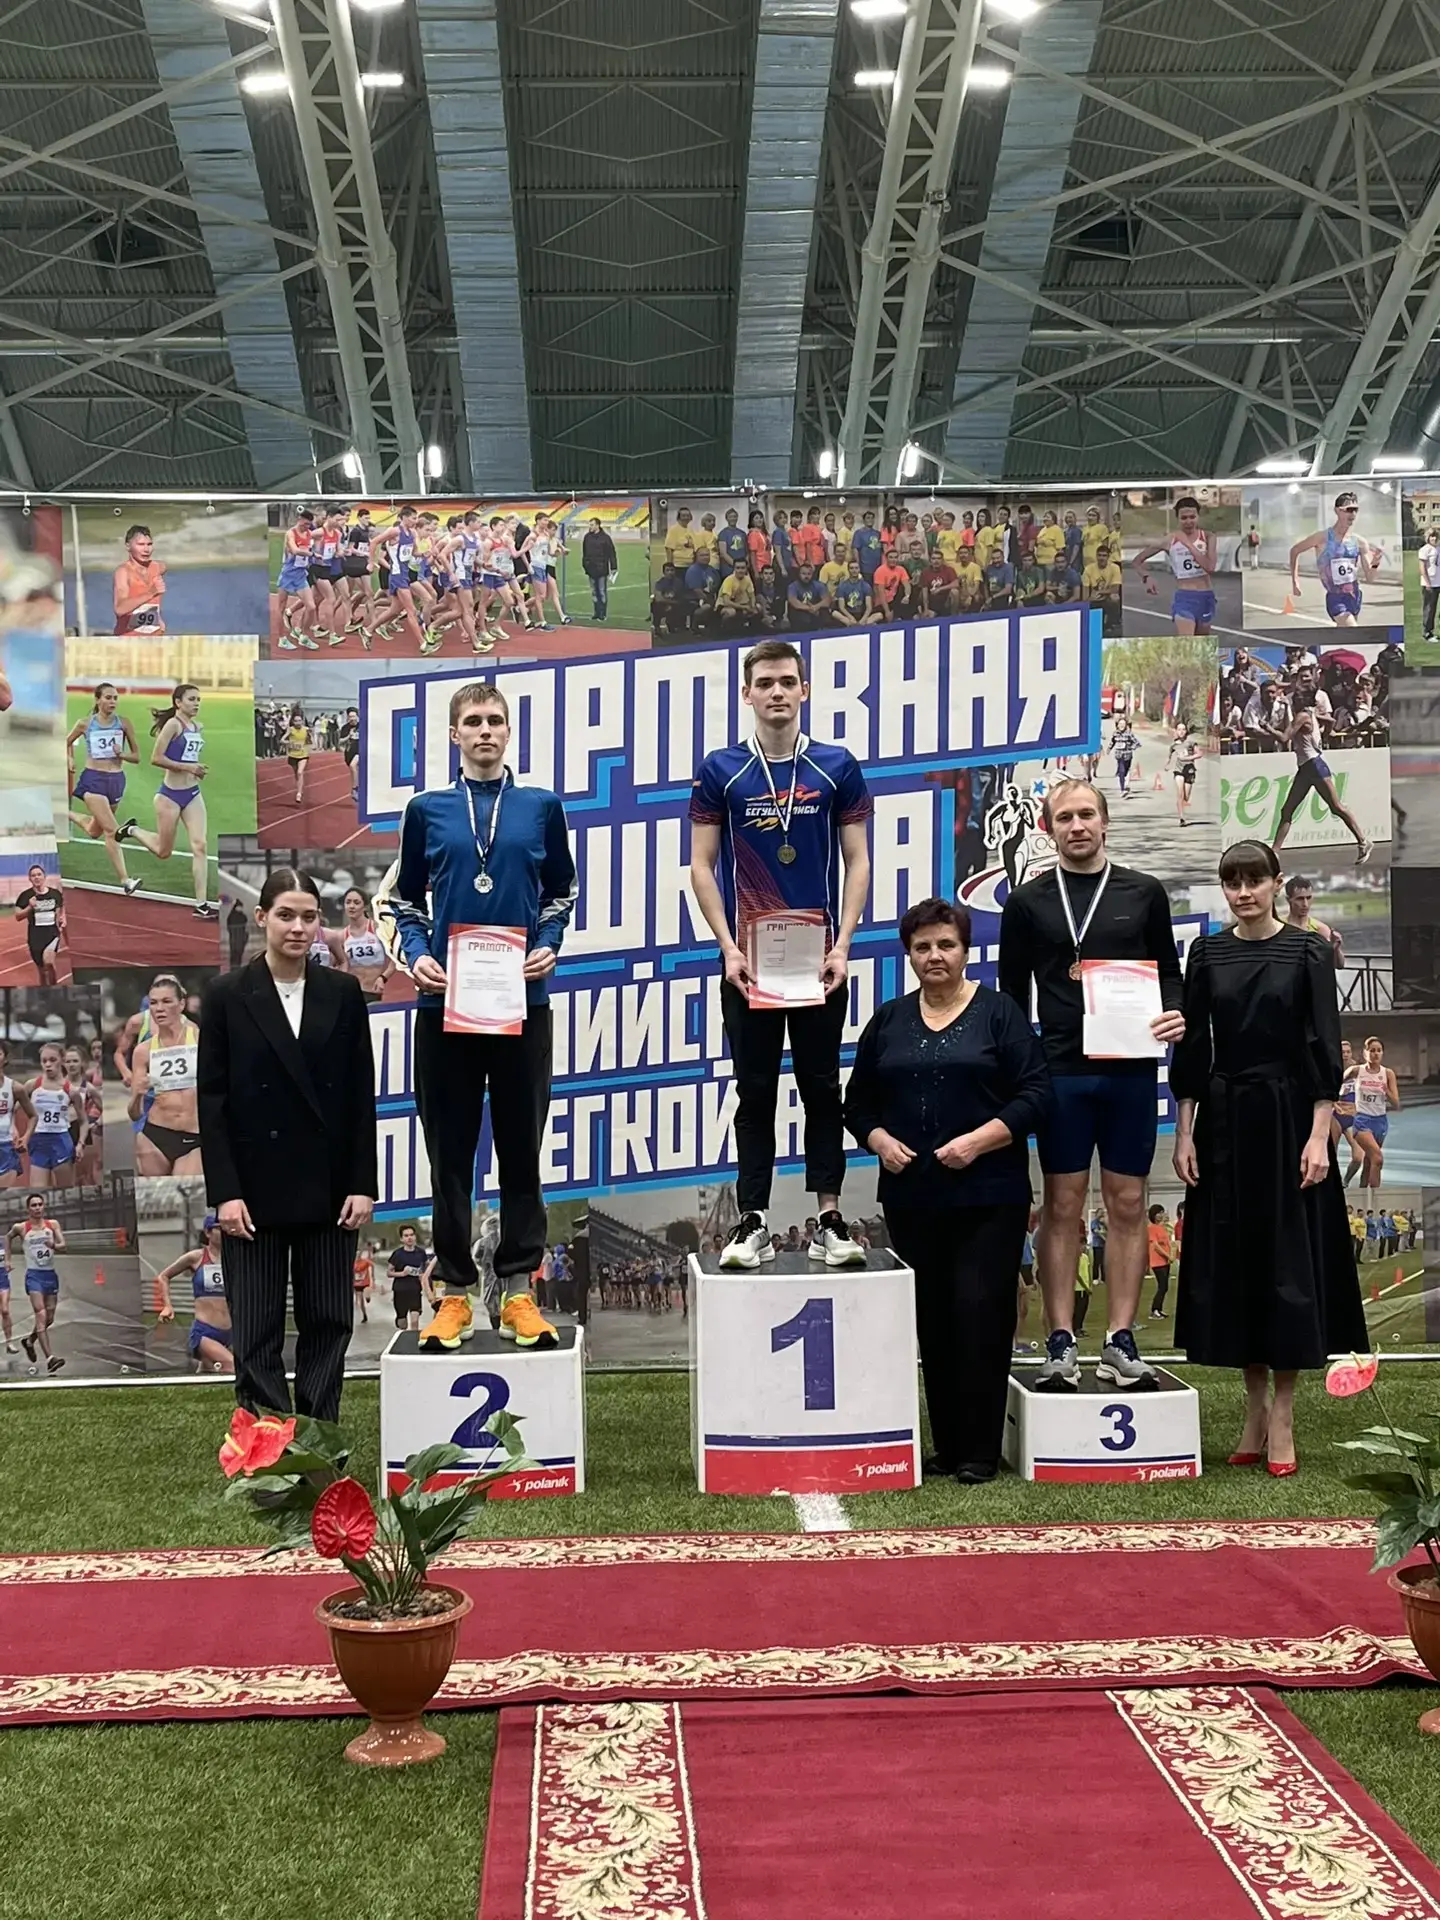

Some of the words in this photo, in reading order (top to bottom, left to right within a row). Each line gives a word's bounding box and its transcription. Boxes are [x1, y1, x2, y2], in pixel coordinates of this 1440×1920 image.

[137, 613, 154, 625] 99
[367, 611, 1082, 815] СПОРТВНАЯ
[98, 737, 116, 749] 34
[557, 790, 933, 958] ШКА
[347, 946, 374, 959] 133
[468, 941, 513, 952] ГРАМОТА
[160, 1057, 188, 1077] 23
[43, 1111, 60, 1123] 85
[37, 1249, 50, 1259] 84
[771, 1298, 835, 1411] 1
[449, 1372, 510, 1448] 2
[1099, 1404, 1137, 1451] 3
[866, 1460, 909, 1478] polanik
[1149, 1464, 1191, 1481] polanik
[523, 1475, 570, 1493] polanik
